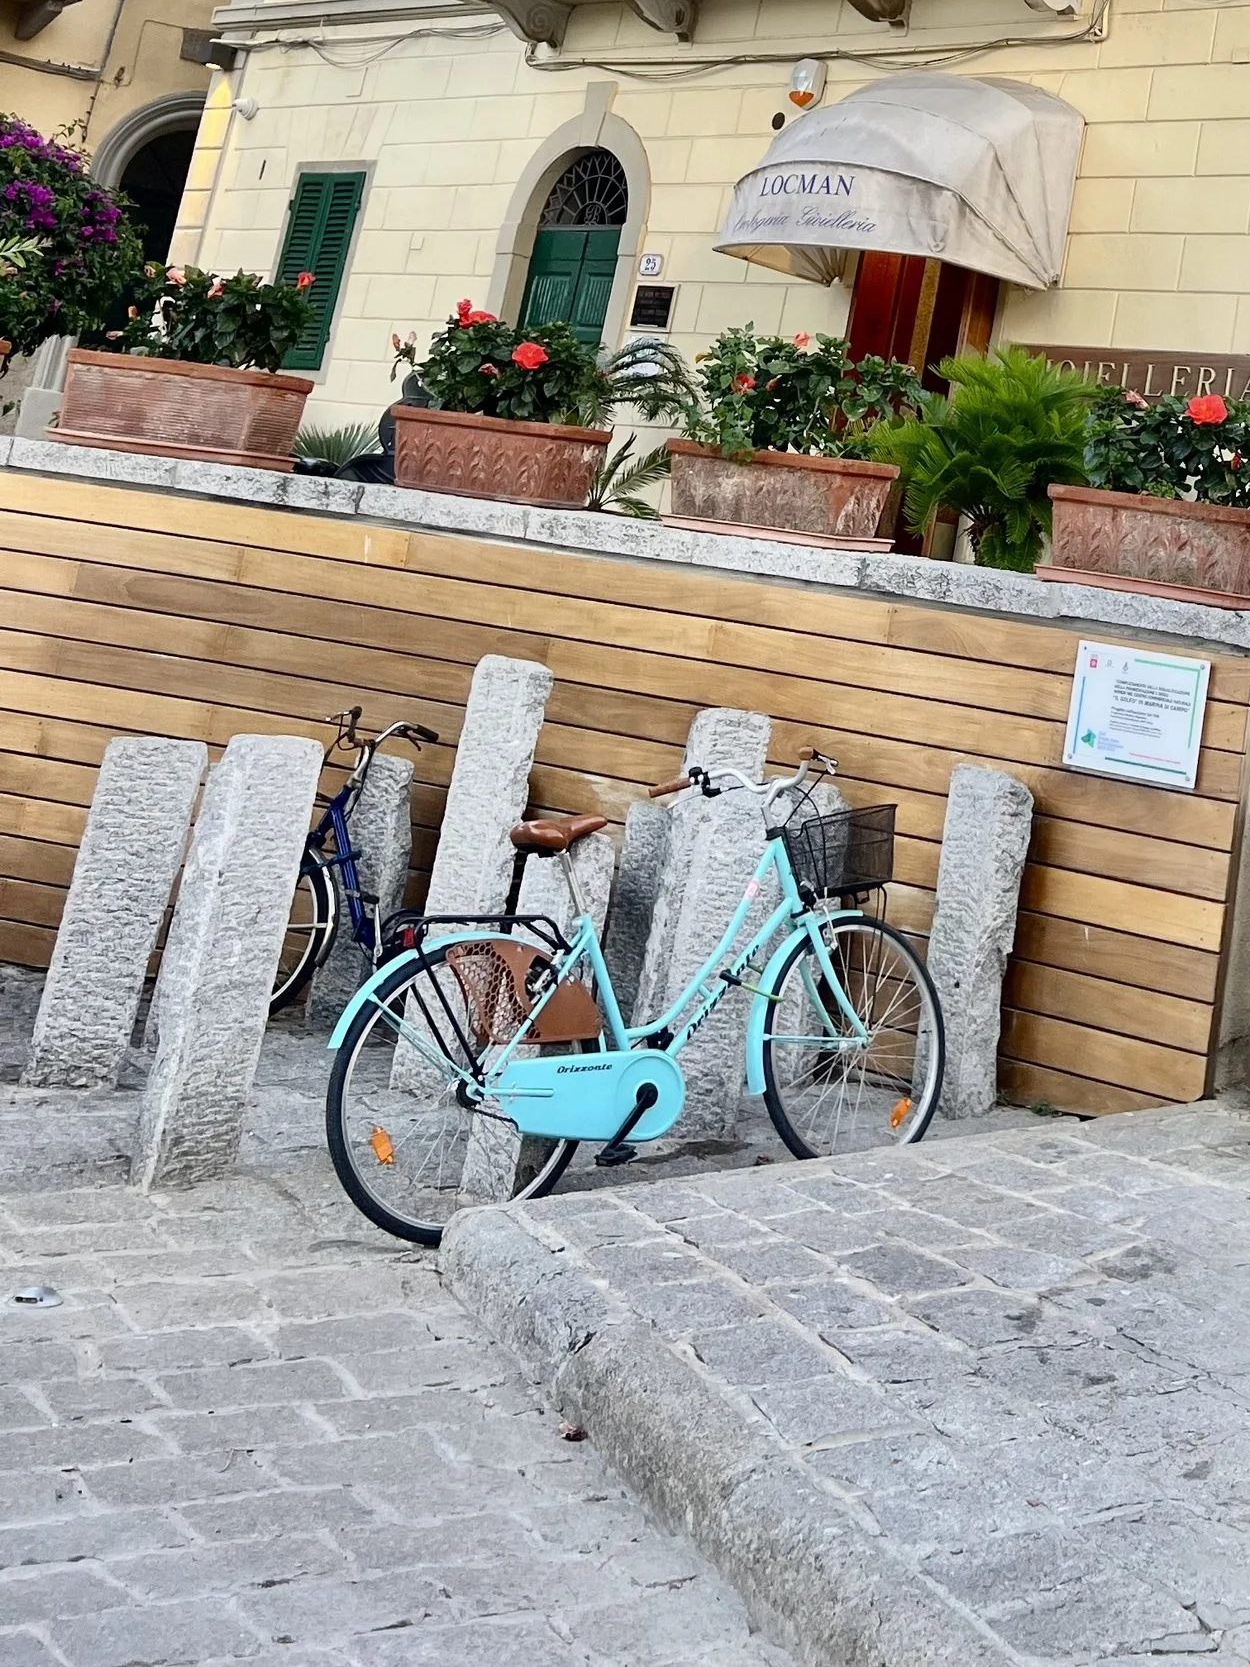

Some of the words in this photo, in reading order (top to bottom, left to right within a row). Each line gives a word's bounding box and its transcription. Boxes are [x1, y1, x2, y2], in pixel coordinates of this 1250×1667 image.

[759, 173, 856, 197] LOCMAN
[795, 206, 877, 233] Gioielleria
[557, 1063, 613, 1074] Orizzonte
